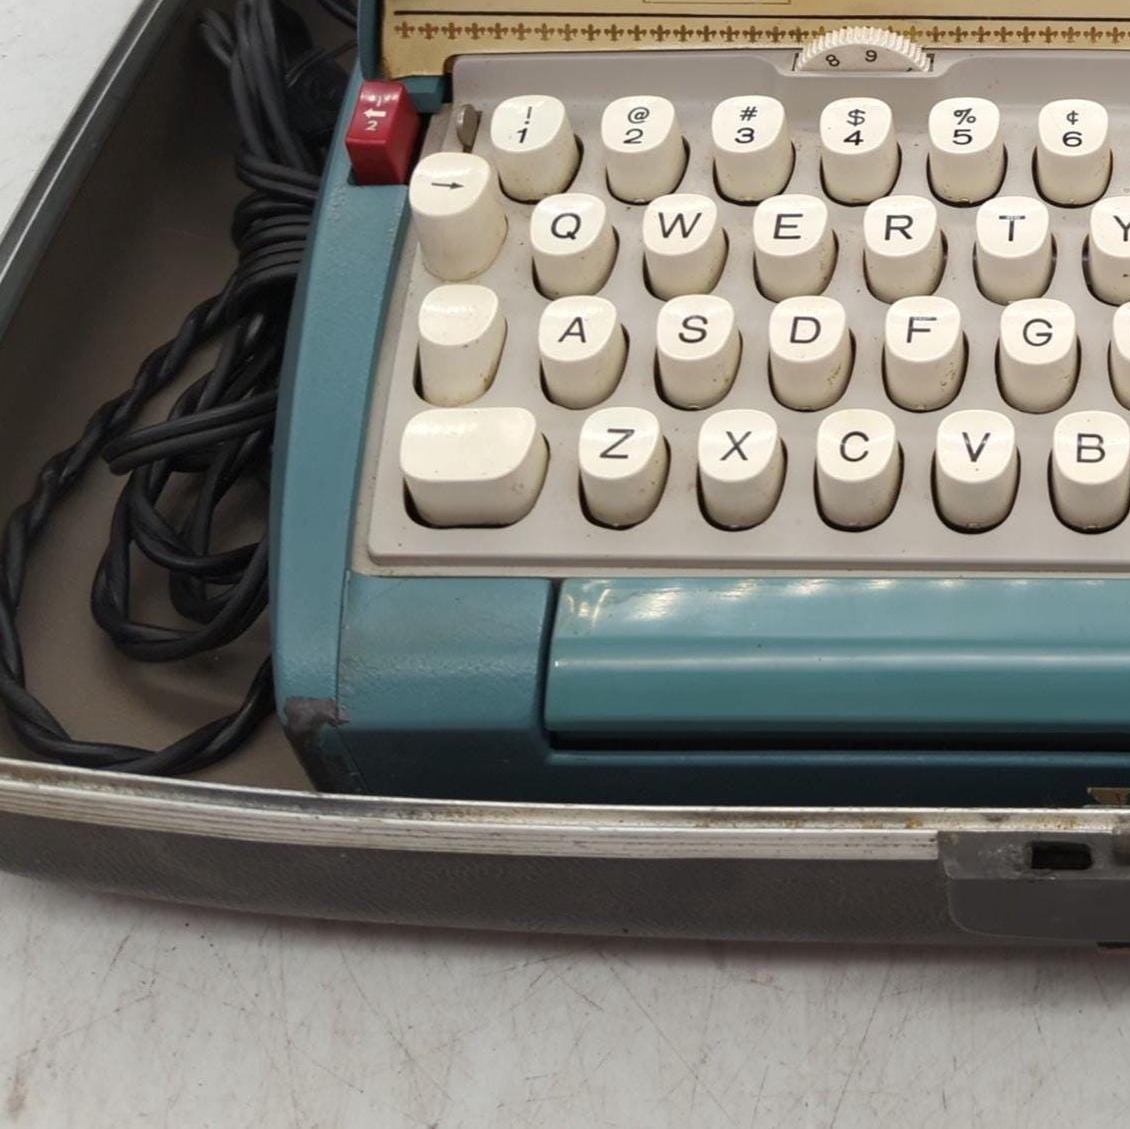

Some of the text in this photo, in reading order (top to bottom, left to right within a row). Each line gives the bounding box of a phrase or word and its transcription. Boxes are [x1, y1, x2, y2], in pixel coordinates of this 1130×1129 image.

[825, 49, 878, 68] 8 9
[366, 120, 378, 131] 2
[627, 106, 651, 125] @
[739, 106, 758, 122] #
[846, 108, 866, 127] $
[953, 107, 977, 126] %
[517, 127, 528, 144] 1
[623, 128, 644, 145] 2
[734, 127, 755, 144] 3
[843, 129, 864, 146] 4
[952, 128, 973, 146] 5
[1062, 130, 1083, 148] 6
[550, 212, 582, 241] Q
[658, 211, 703, 239] W
[772, 213, 804, 240] E
[884, 214, 914, 241] R
[998, 215, 1026, 242] T
[557, 316, 587, 344] A
[678, 314, 709, 344] S
[789, 316, 822, 344] D
[906, 316, 937, 344] F
[1022, 318, 1053, 347] G
[599, 428, 635, 460] Z
[720, 430, 752, 461] X
[839, 430, 870, 463] C
[961, 431, 991, 463] V
[1076, 432, 1106, 464] B
